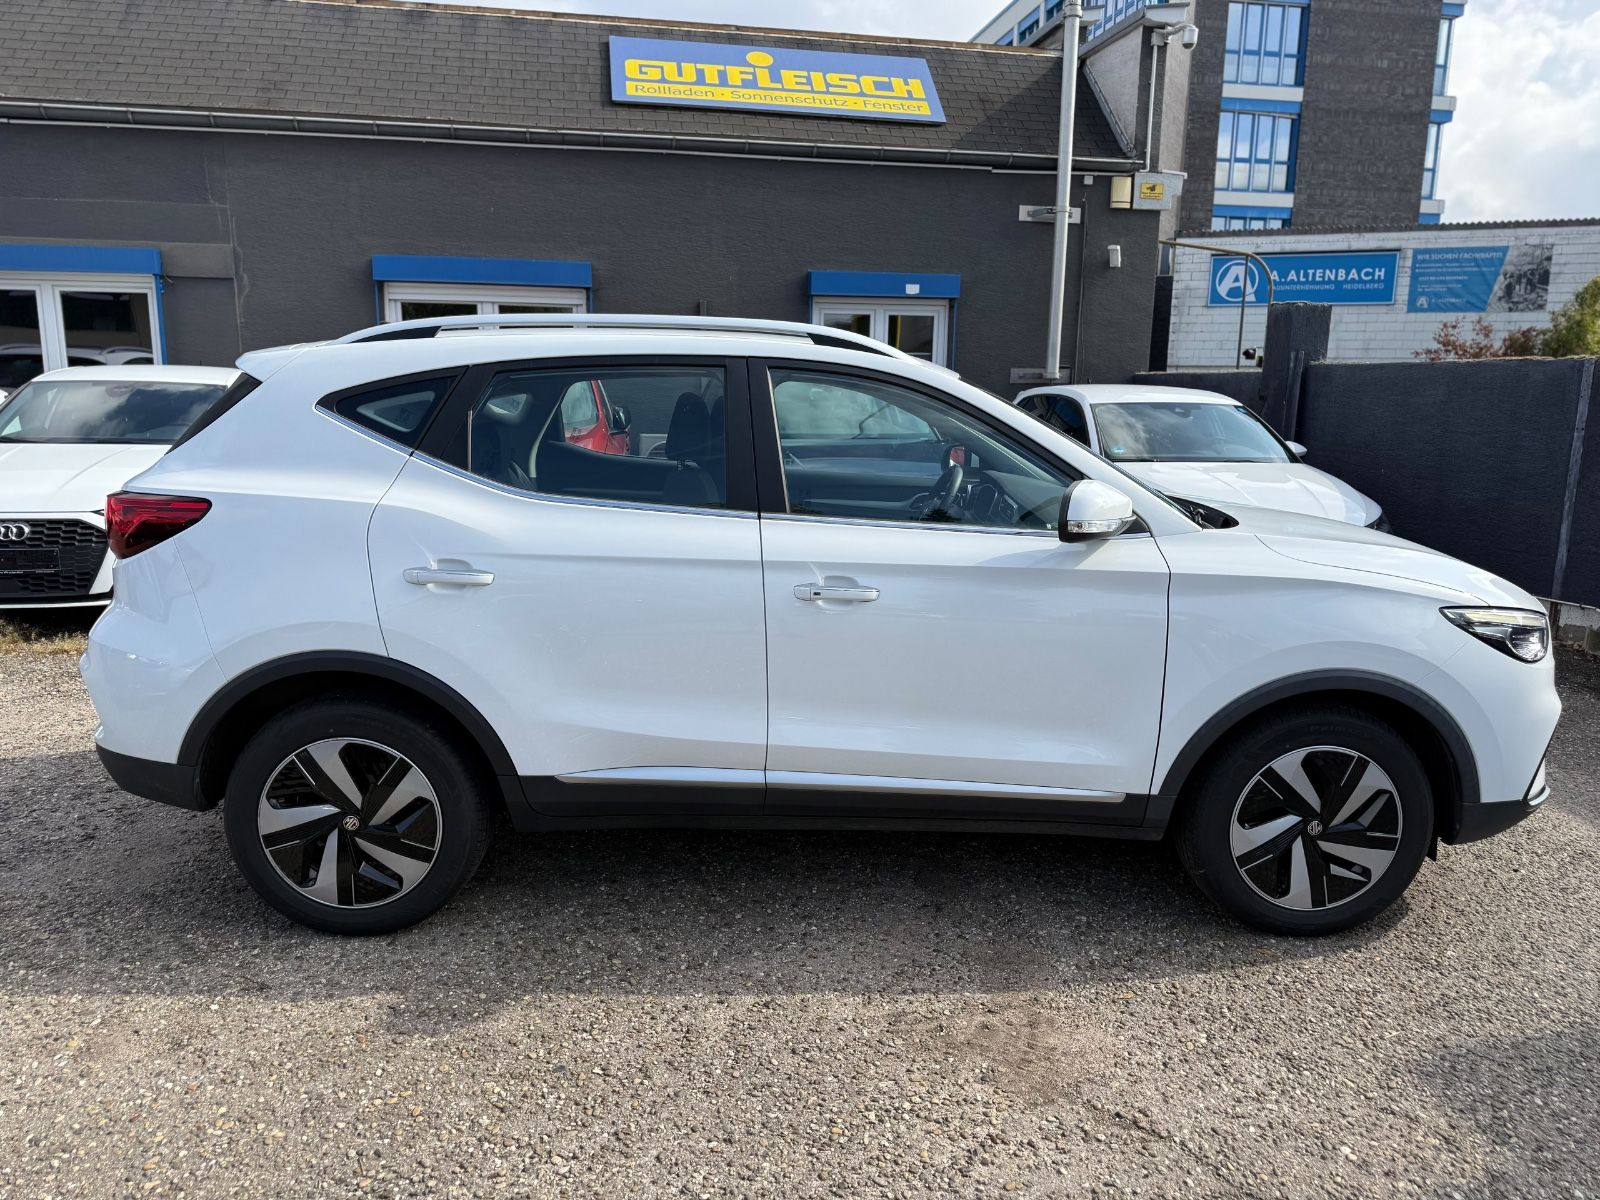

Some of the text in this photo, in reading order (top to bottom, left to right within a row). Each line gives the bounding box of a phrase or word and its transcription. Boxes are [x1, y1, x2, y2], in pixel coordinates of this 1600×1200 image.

[624, 51, 926, 99] GUTFLEISCH
[634, 84, 923, 112] Rollladen Sonnenschutz Fenster
[1343, 282, 1385, 290] HEIDELBERG
